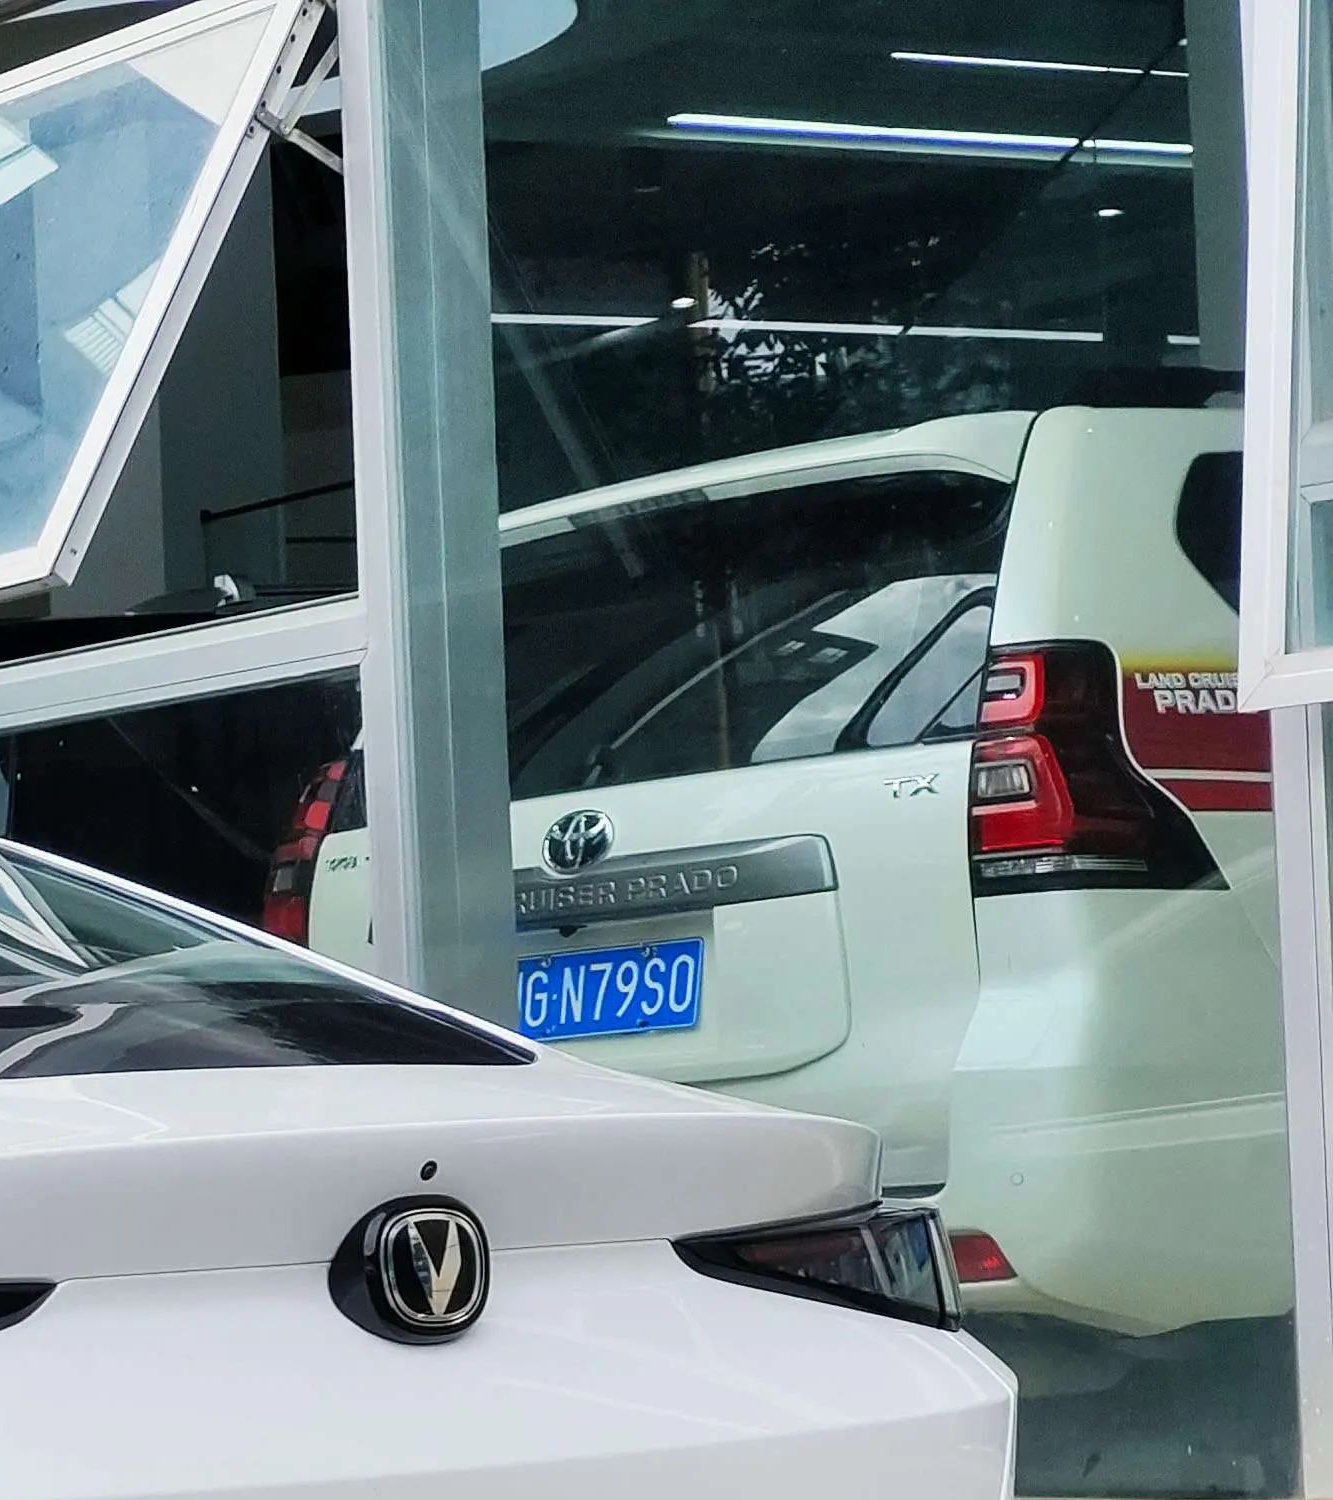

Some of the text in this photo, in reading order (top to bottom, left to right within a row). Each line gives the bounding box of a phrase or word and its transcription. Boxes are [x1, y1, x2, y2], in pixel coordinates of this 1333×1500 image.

[1134, 672, 1186, 690] LAND
[1153, 689, 1238, 715] PRAD
[883, 773, 940, 799] TX
[516, 864, 740, 915] RUISER PRADO
[518, 953, 696, 1029] G·N79S0
